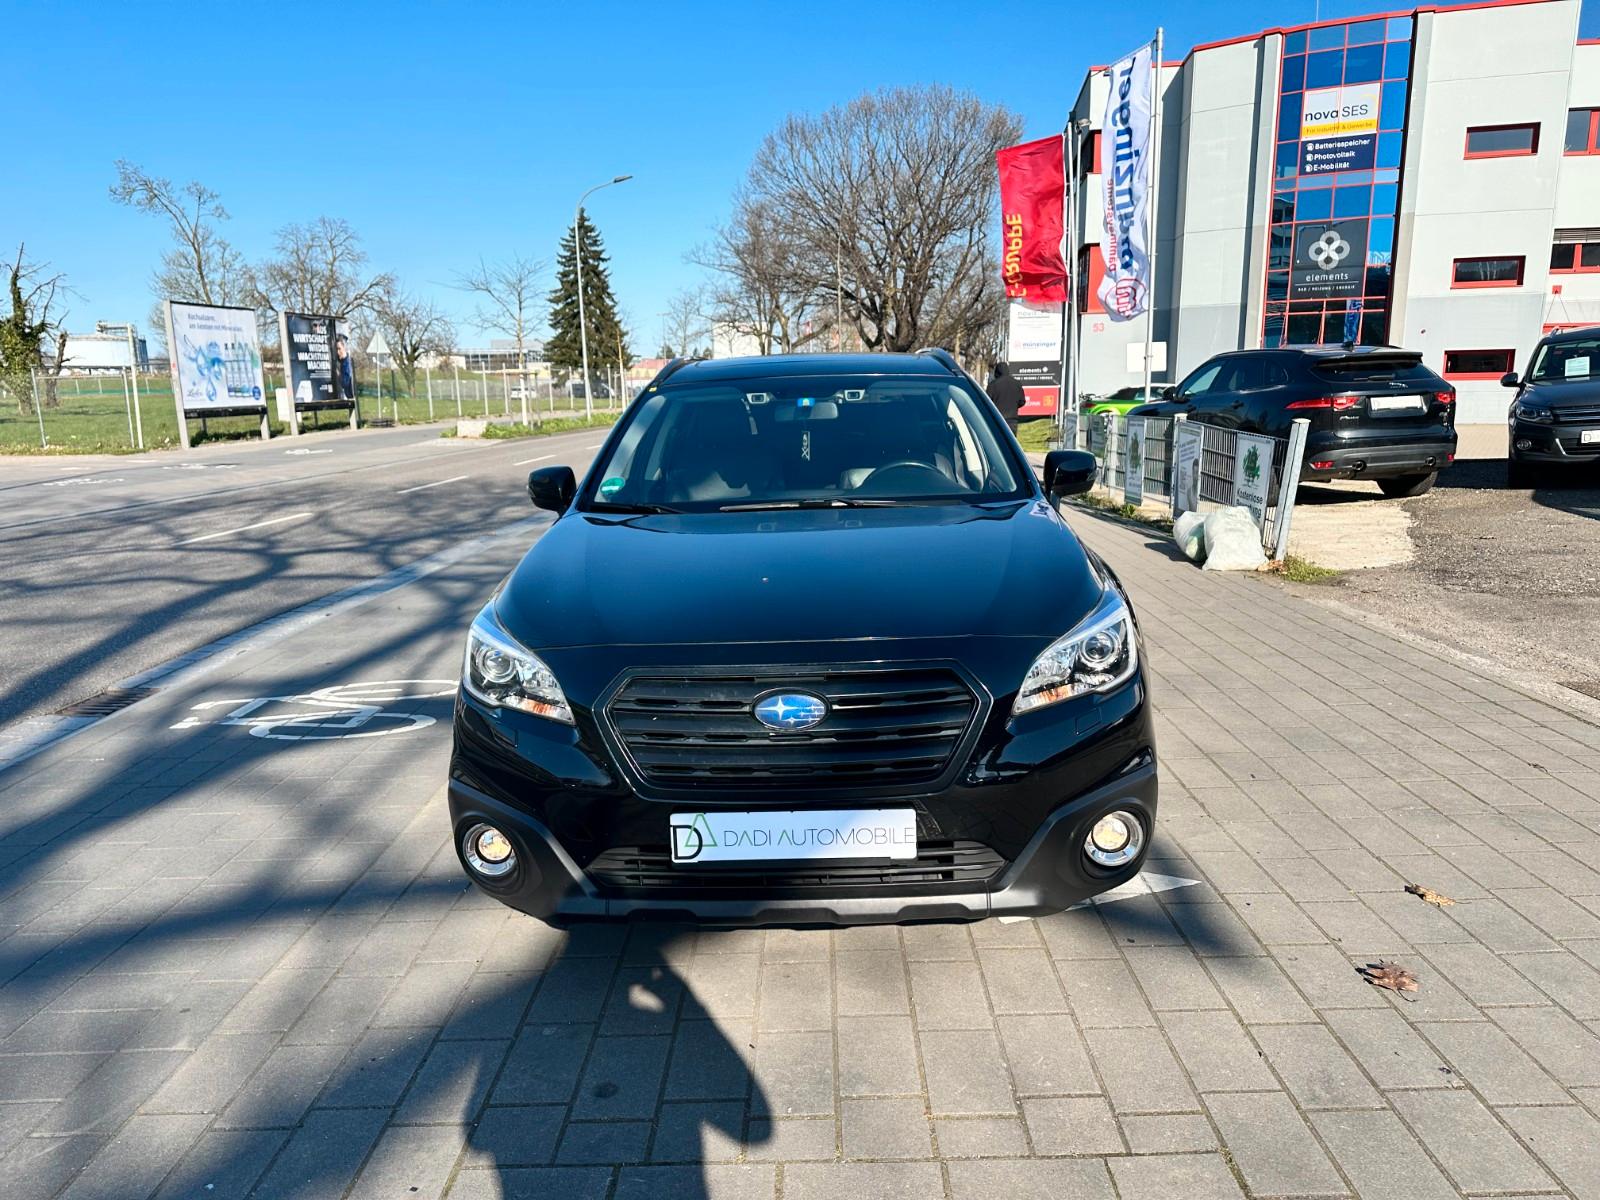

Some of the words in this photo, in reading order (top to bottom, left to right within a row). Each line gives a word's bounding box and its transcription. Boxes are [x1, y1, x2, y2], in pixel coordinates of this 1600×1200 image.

[1305, 109, 1339, 121] nova
[1341, 104, 1368, 118] SES
[1314, 139, 1371, 150] Batteriespeicher
[1313, 151, 1355, 160] Photovoltaik
[1313, 162, 1350, 171] E-Mobilität
[1305, 272, 1349, 282] elements
[1092, 322, 1105, 333] 53
[292, 333, 328, 343] WIRTSCHAFT
[1237, 487, 1264, 505] Kostenlose
[723, 829, 772, 847] DADI
[777, 827, 916, 846] AUTOMOBILE
